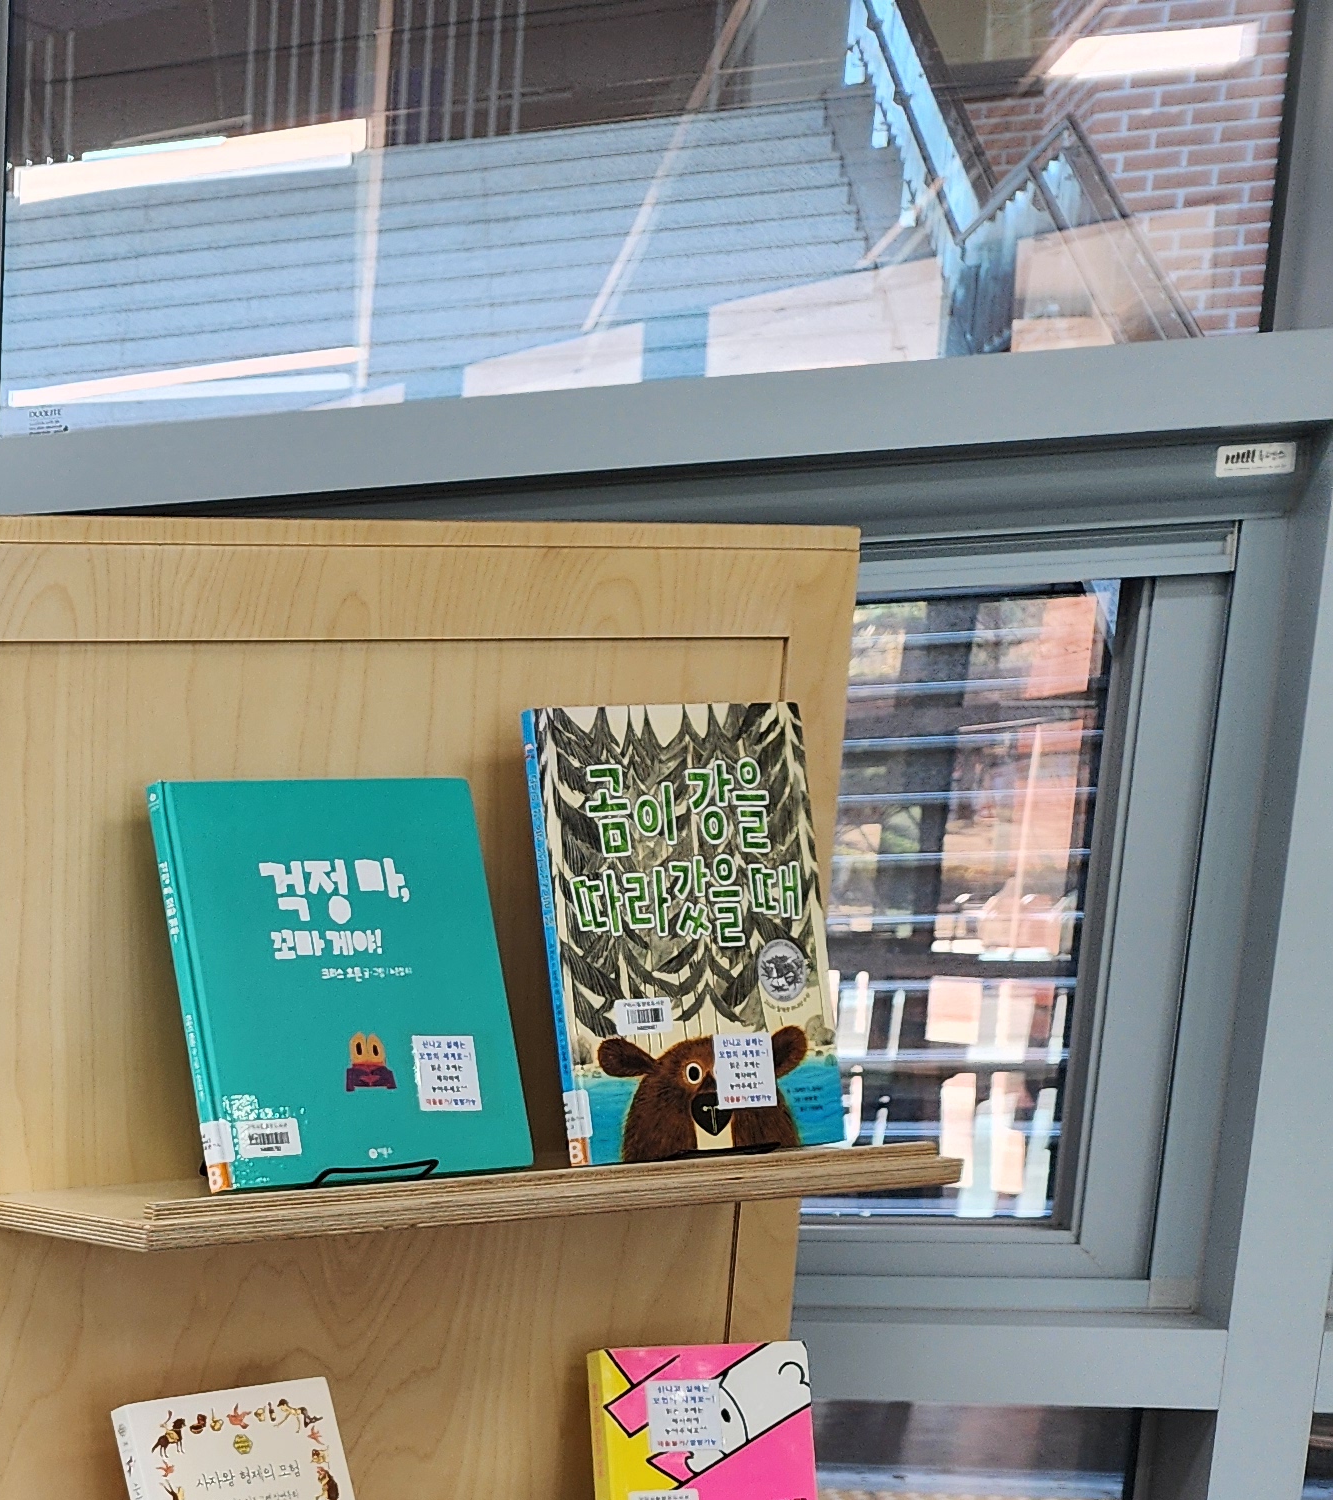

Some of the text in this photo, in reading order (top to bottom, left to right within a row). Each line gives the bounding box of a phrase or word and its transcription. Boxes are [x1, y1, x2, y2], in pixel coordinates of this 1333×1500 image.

[587, 764, 677, 857] 곰이
[686, 757, 772, 855] 강을
[259, 858, 409, 924] 걱정 마,
[570, 856, 803, 948] 따라갔을 때
[271, 929, 382, 959] 꼬마 게야!
[196, 1460, 300, 1491] 사자왕 형제의 모험
